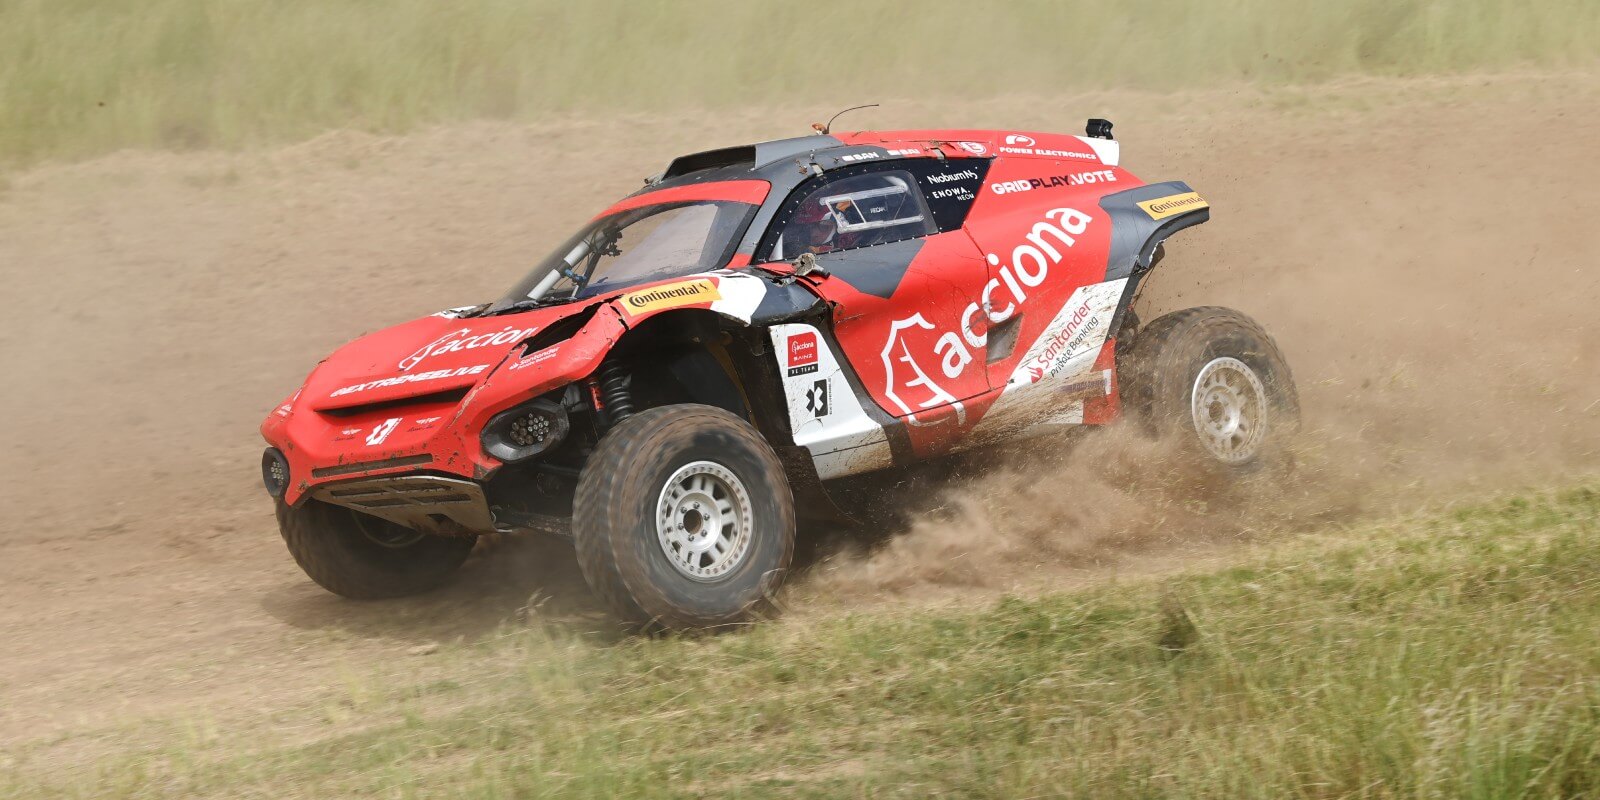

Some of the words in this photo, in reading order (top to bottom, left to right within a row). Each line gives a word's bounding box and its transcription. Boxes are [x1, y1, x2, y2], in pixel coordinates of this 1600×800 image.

[1035, 149, 1096, 160] ELECTRONICS
[991, 170, 1117, 195] GRIDPLAY.VOTE
[628, 284, 700, 307] Continental
[933, 207, 1093, 379] acciona
[1038, 300, 1091, 369] Santander
[1050, 349, 1073, 377] Private
[1068, 316, 1099, 351] Banking
